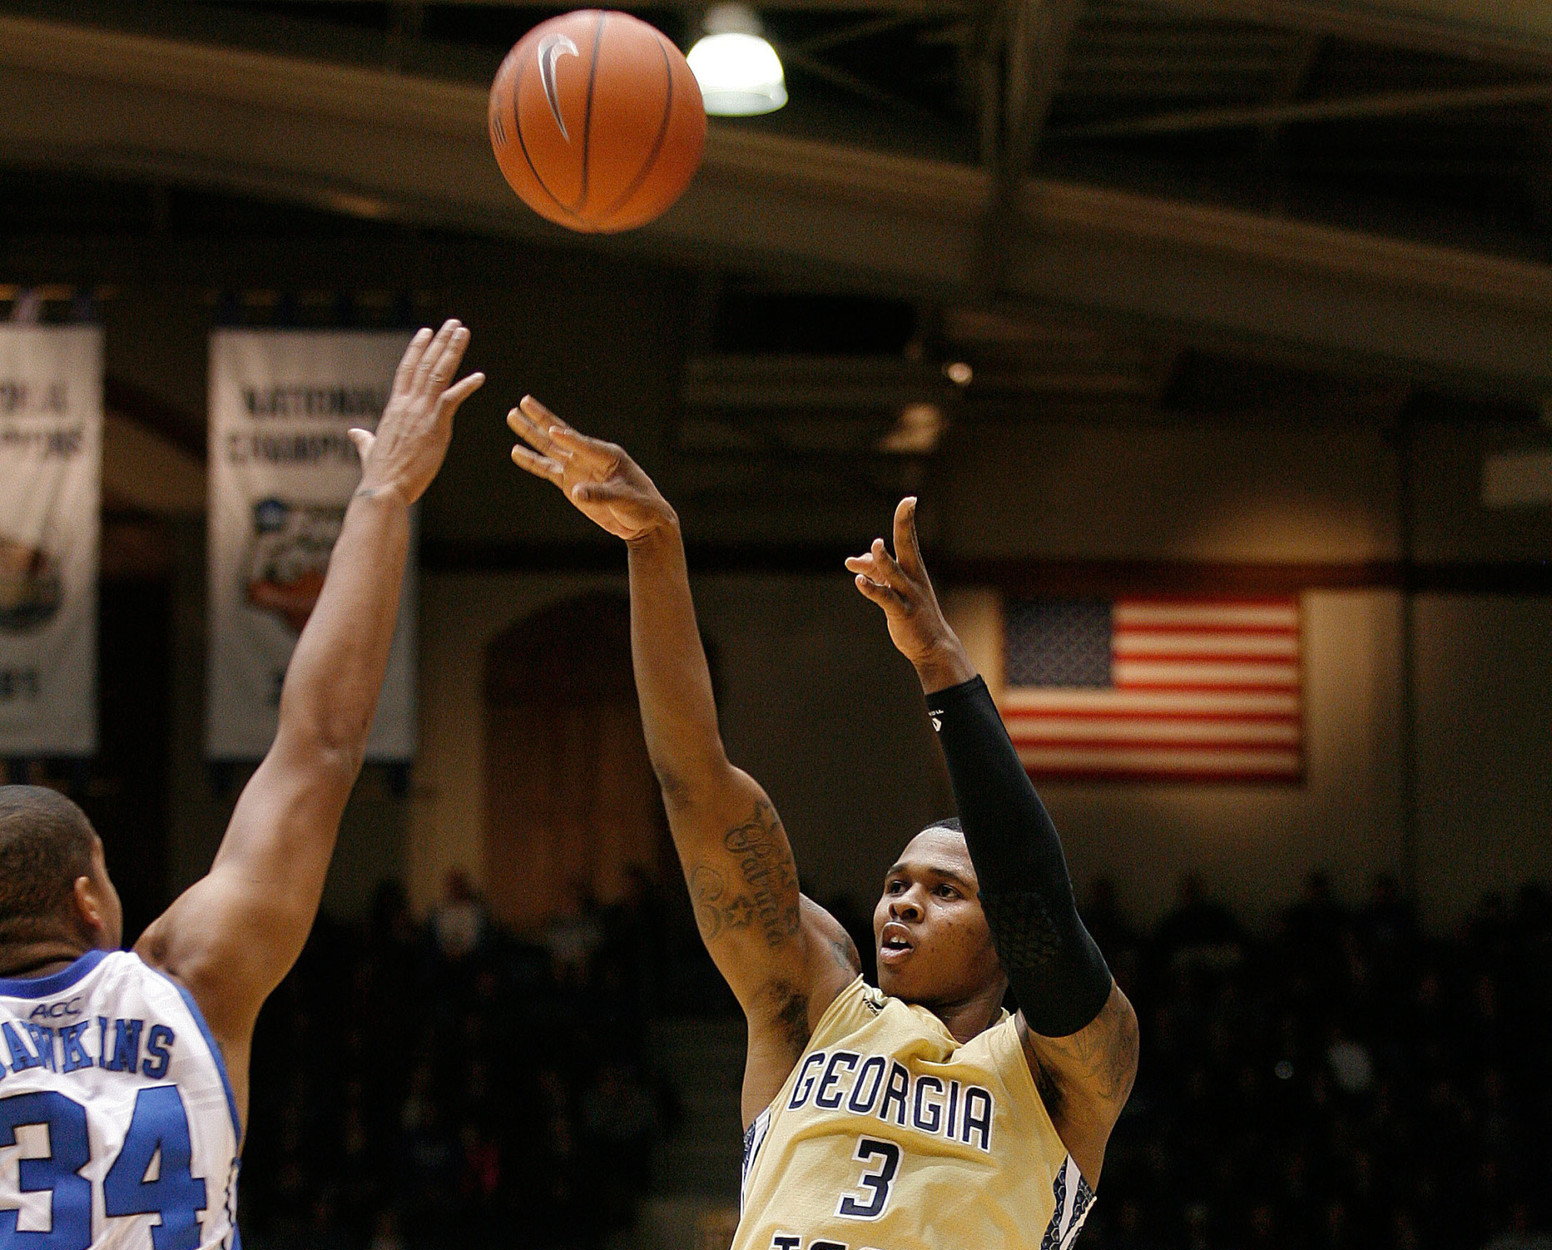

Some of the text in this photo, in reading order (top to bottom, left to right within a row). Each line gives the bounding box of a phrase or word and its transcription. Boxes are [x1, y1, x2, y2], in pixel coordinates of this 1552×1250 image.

[28, 997, 82, 1020] ACC
[0, 1015, 176, 1081] AWKINS
[786, 1049, 996, 1154] GEORGIA
[833, 1134, 904, 1222] 3
